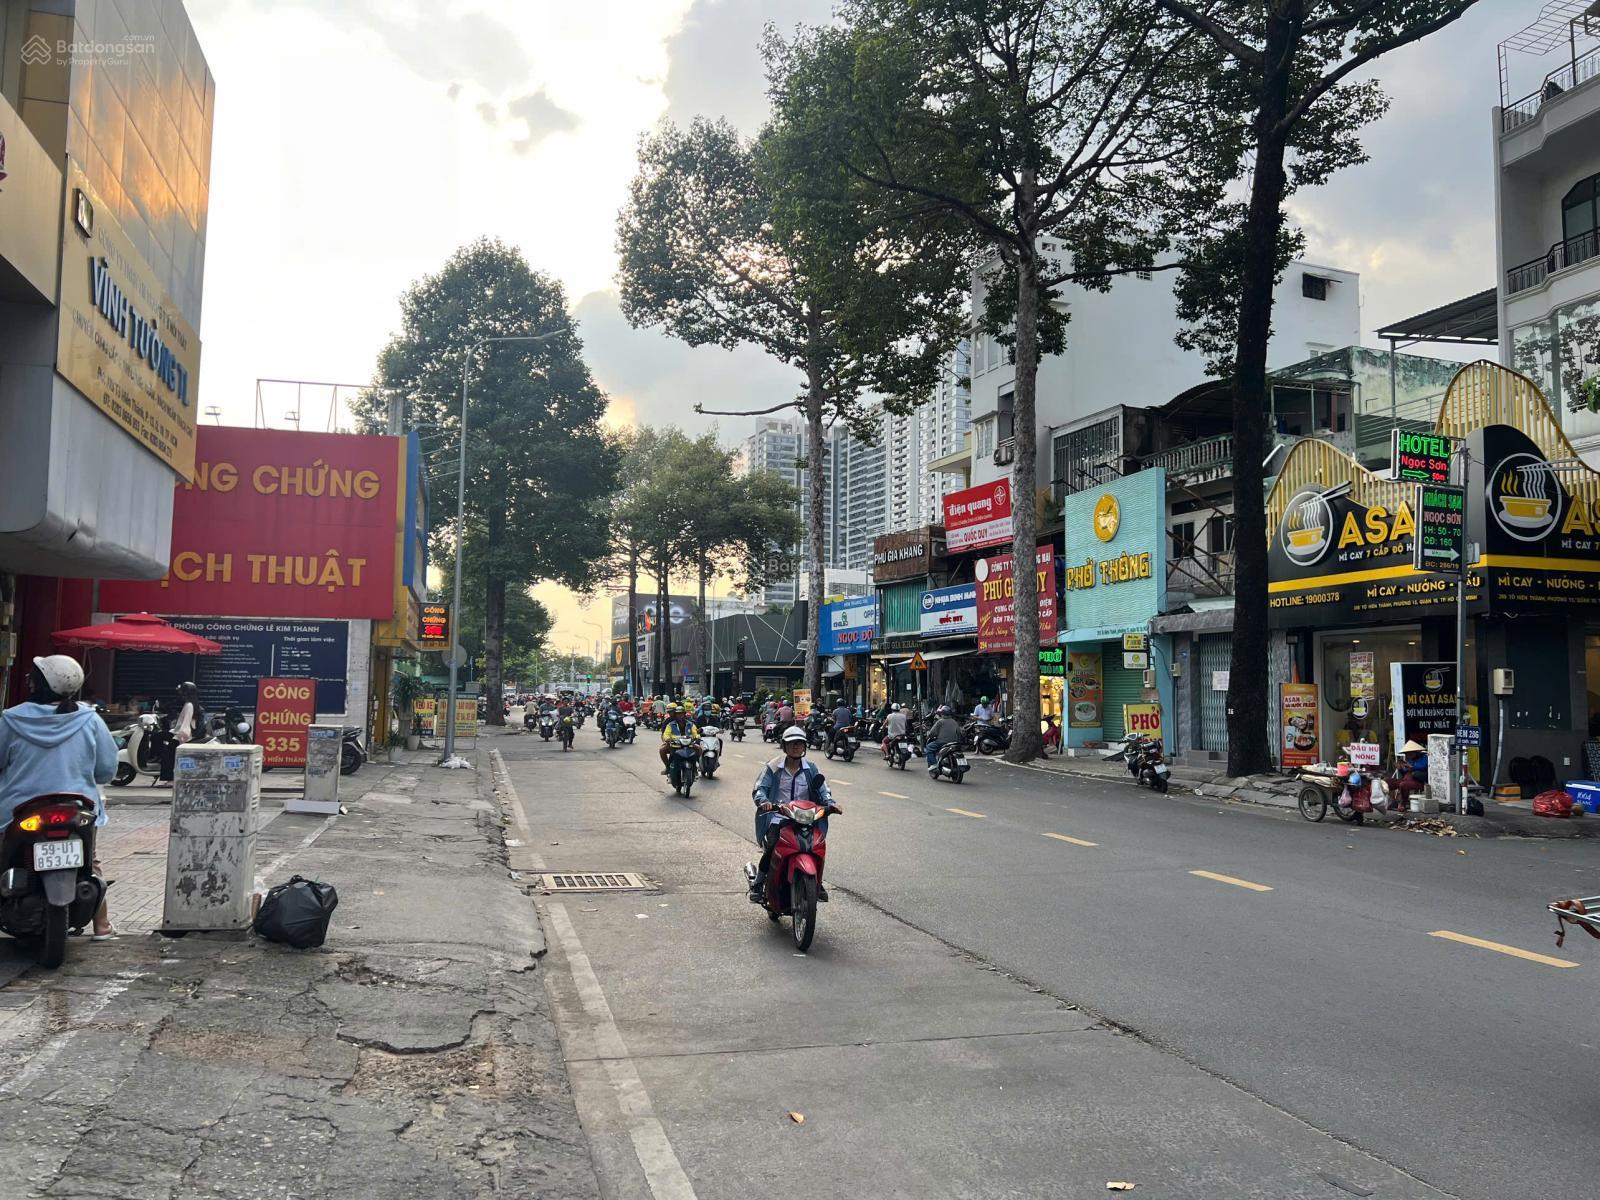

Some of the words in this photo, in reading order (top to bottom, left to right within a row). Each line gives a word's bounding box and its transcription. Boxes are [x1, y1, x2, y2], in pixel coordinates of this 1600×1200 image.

[177, 362, 189, 407] TL
[1400, 434, 1449, 458] HOTEL
[1401, 455, 1426, 469] Ngọc
[1428, 459, 1447, 471] Sơn
[253, 459, 380, 499] CHỨNG
[946, 503, 966, 517] điện
[967, 498, 992, 515] quang
[1424, 489, 1447, 508] KHÁCH
[1448, 495, 1462, 511] SẠN
[1338, 500, 1415, 550] ASA
[1423, 511, 1446, 526] NGỌC
[1446, 511, 1462, 525] SƠN
[964, 528, 976, 543] QUỐC
[978, 528, 988, 540] DUY
[1424, 526, 1436, 535] 1H:
[1438, 527, 1446, 536] 50
[1453, 528, 1461, 537] 70
[1440, 538, 1453, 547] 160
[1562, 538, 1571, 549] MÌ
[1575, 541, 1592, 550] CAY
[875, 548, 886, 565] PHÚ
[887, 550, 898, 562] GIA
[899, 544, 923, 560] KHANG
[1042, 552, 1051, 565] MẠI
[1338, 552, 1348, 562] MÌ
[1349, 550, 1363, 560] CAY
[1366, 550, 1371, 559] 7
[1373, 544, 1389, 557] CẤP
[248, 548, 366, 592] THUẬT
[991, 561, 1002, 573] CÔNG
[1003, 562, 1009, 570] TY
[1066, 557, 1096, 591] PHỞ
[1100, 551, 1152, 585] THÔNG
[983, 574, 1003, 601] PHÚ
[1367, 584, 1377, 598] MÌ
[1379, 585, 1397, 596] CAY
[1407, 578, 1446, 594] NƯỚNG
[1466, 571, 1481, 587] ẨU
[1498, 572, 1510, 587] MÌ
[1513, 577, 1533, 588] CAY
[1547, 575, 1585, 590] NƯỚNG
[1270, 595, 1304, 608] HOTLINE:
[1305, 592, 1340, 605] 19000378
[275, 625, 291, 633] KIM
[263, 683, 311, 700] CÔNG
[1407, 692, 1417, 705] MÌ
[1419, 694, 1436, 704] CAY
[259, 708, 312, 726] CHỨNG
[1131, 706, 1160, 731] PHỞ
[1419, 721, 1431, 729] DUY
[1434, 718, 1450, 729] NHẤT
[265, 737, 301, 752] 335
[41, 841, 74, 855] 59-U1
[37, 854, 81, 868] 853.42
